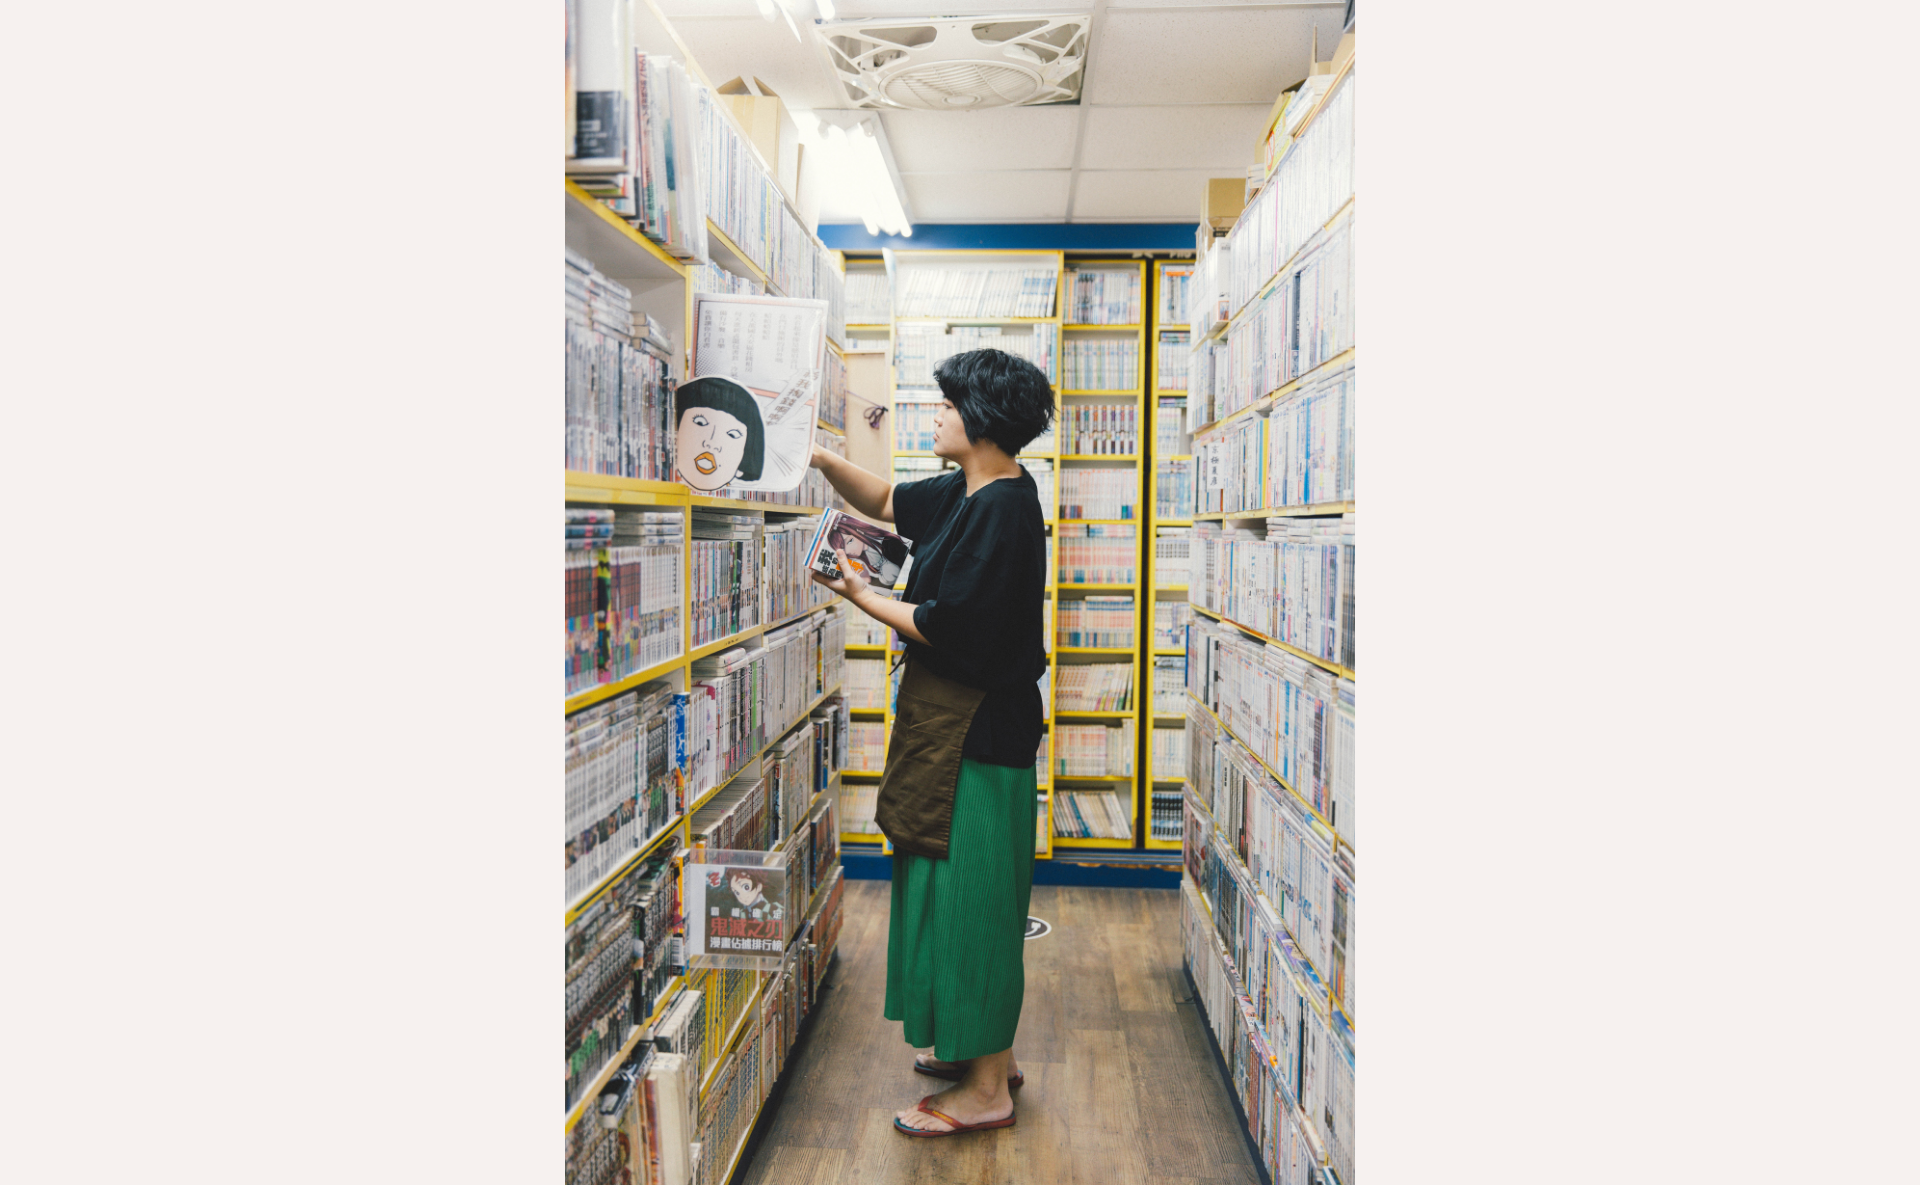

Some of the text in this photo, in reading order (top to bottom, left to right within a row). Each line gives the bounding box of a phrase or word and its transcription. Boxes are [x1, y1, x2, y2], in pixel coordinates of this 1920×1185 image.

[710, 916, 783, 939] 鬼滅之刃
[709, 936, 782, 951] 漫畫佔據排行榜
